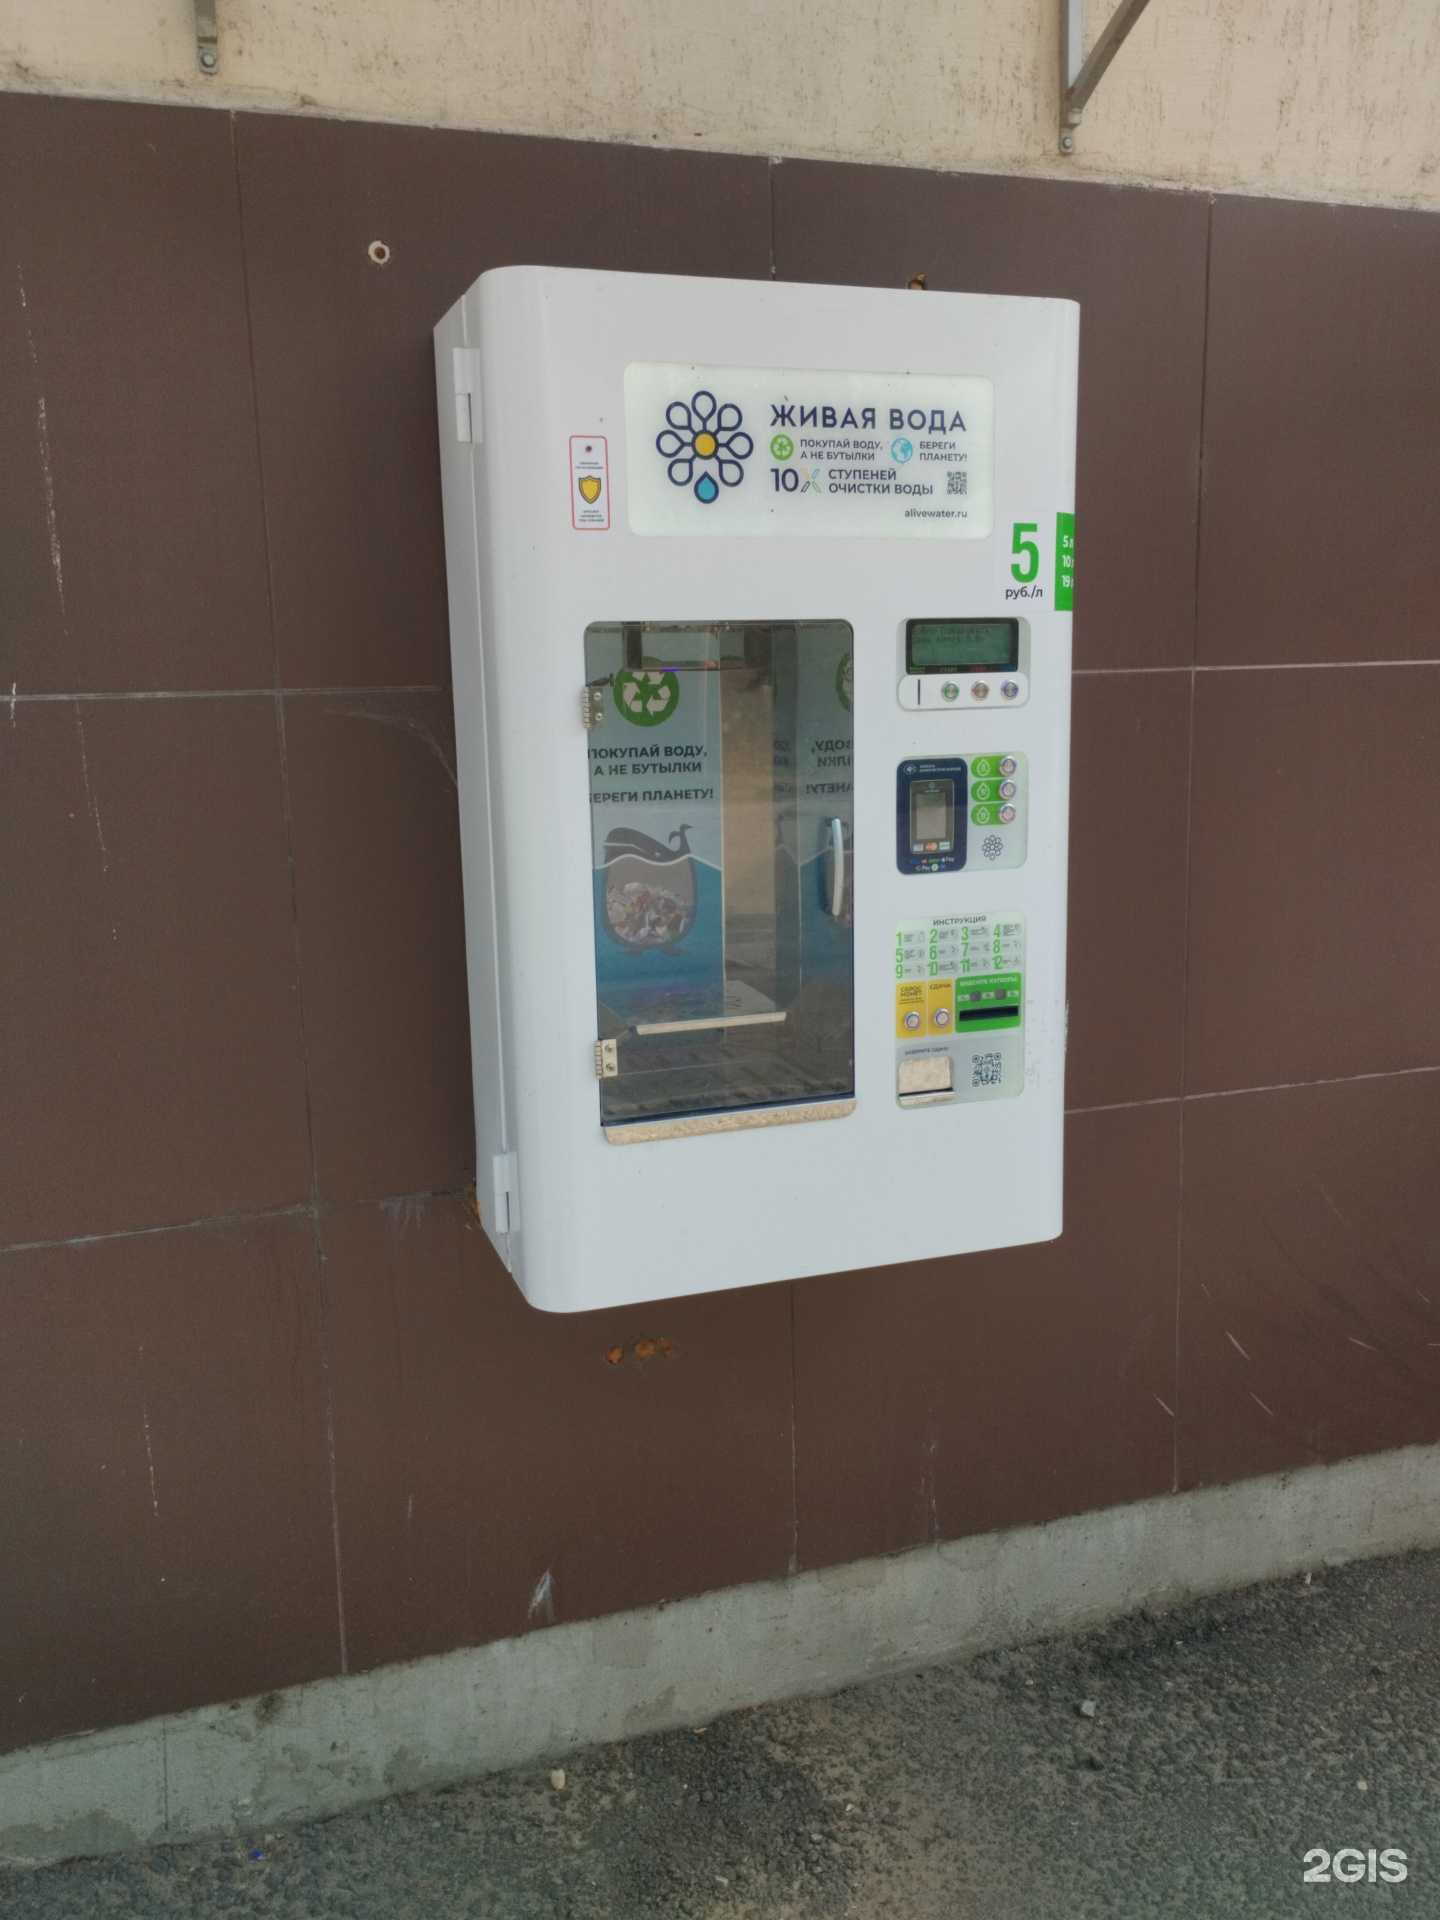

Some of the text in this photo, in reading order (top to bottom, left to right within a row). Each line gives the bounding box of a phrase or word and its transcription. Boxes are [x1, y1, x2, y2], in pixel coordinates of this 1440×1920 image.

[770, 404, 967, 435] ЖИВАЯ ВОДА
[800, 438, 883, 450] ПОКУПАЙ ВОДУ,
[919, 441, 956, 450] БЕРЕГИ
[800, 451, 875, 461] А НЕ БУТЫЛКИ
[919, 452, 968, 462] ПЛАНЕТУ!
[770, 467, 799, 492] 10
[828, 468, 897, 481] СТУПЕНЕЙ
[828, 483, 934, 496] ОЧИСТКИ ВОДЫ
[904, 508, 968, 519] alivewater.ru
[1010, 522, 1039, 583] 5
[1005, 585, 1043, 600] руб./л
[664, 745, 708, 758] ВОДУ,
[593, 762, 702, 776] А НЕ БУТЫЛКИ
[590, 788, 714, 804] ЕРЕГИ ПЛАНЕТУ!
[929, 928, 938, 944] 2
[961, 926, 969, 941] 3
[896, 948, 903, 962] 5
[961, 943, 969, 957] 7
